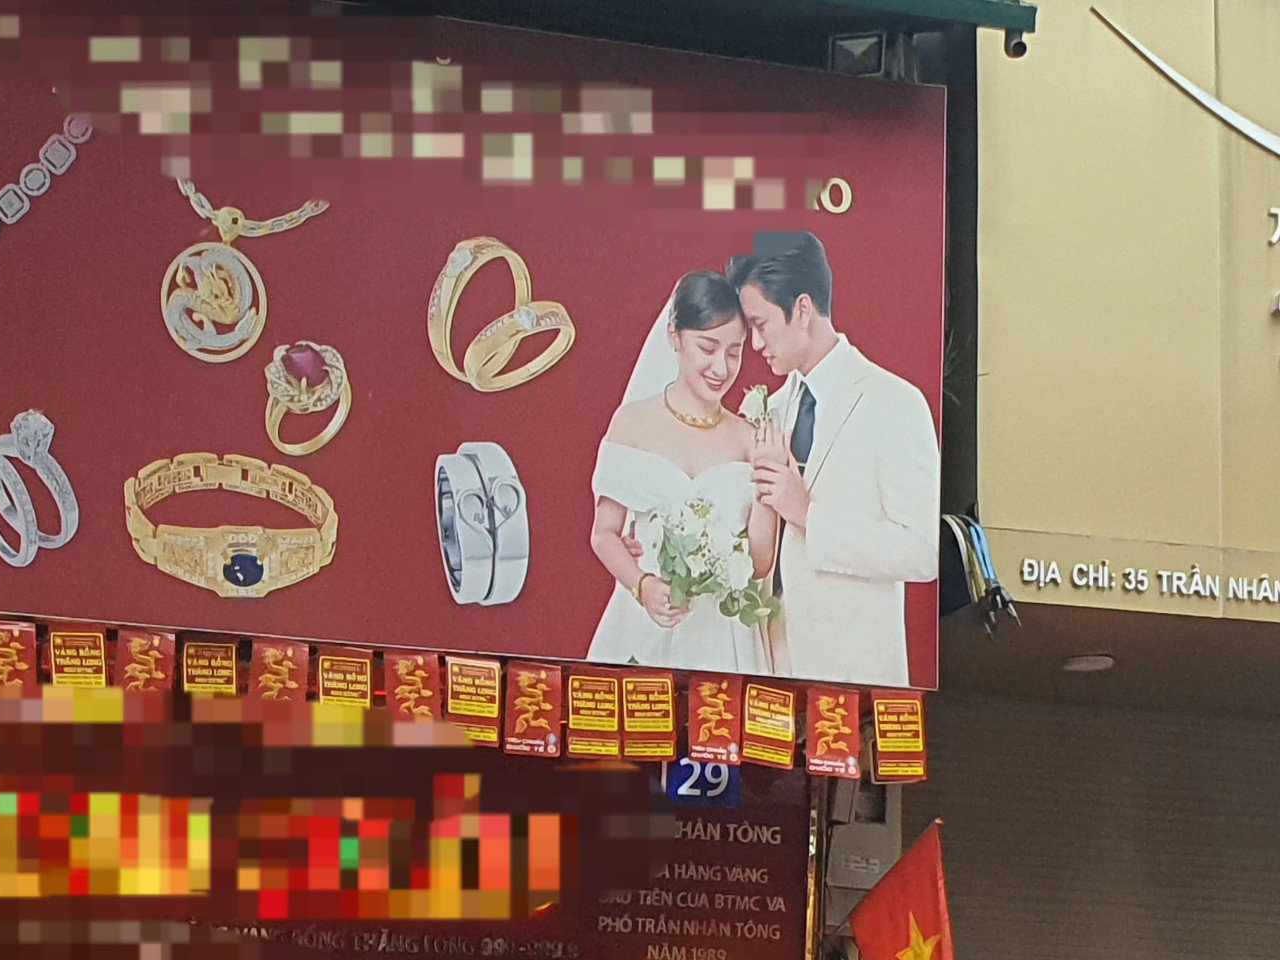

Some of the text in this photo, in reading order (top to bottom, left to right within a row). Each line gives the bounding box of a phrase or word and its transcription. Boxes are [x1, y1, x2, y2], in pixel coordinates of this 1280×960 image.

[1023, 558, 1061, 587] ĐỊA
[1072, 559, 1116, 588] CHỈ:
[1124, 567, 1149, 591] 35
[1158, 563, 1220, 597] TRẦN
[677, 757, 729, 797] 29
[715, 895, 760, 911] BTMC
